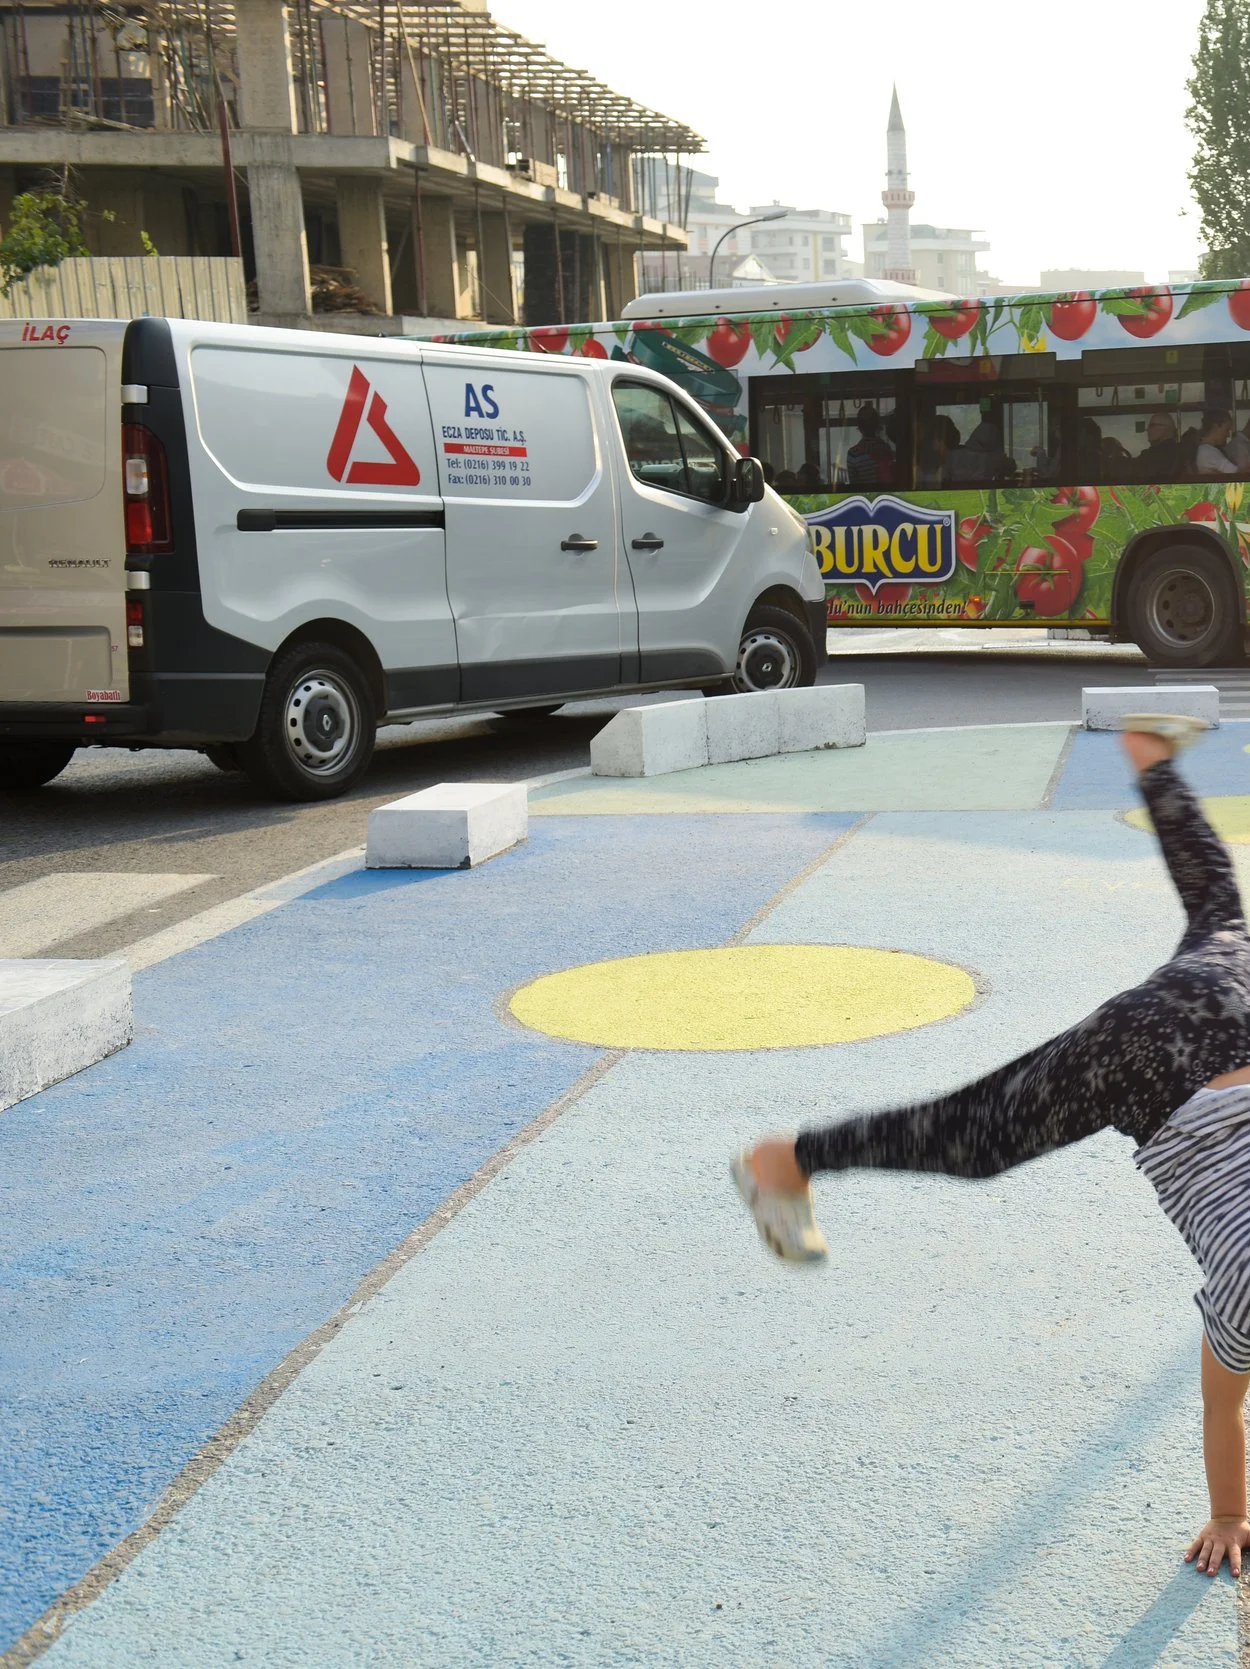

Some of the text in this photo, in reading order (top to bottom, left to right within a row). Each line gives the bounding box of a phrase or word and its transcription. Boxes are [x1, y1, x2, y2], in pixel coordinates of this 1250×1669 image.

[22, 322, 71, 345] İLAÇ
[464, 383, 499, 419] AS
[442, 426, 527, 446] ECZA DEPOSU TİC. A.Ş.
[463, 445, 489, 454] MALTEPE
[447, 458, 530, 472] Tel: (0216) 399 19 22
[448, 473, 532, 486] Fax: (0216) 310 00 30
[808, 522, 944, 578] BURCU
[877, 599, 967, 619] bahçesinden!
